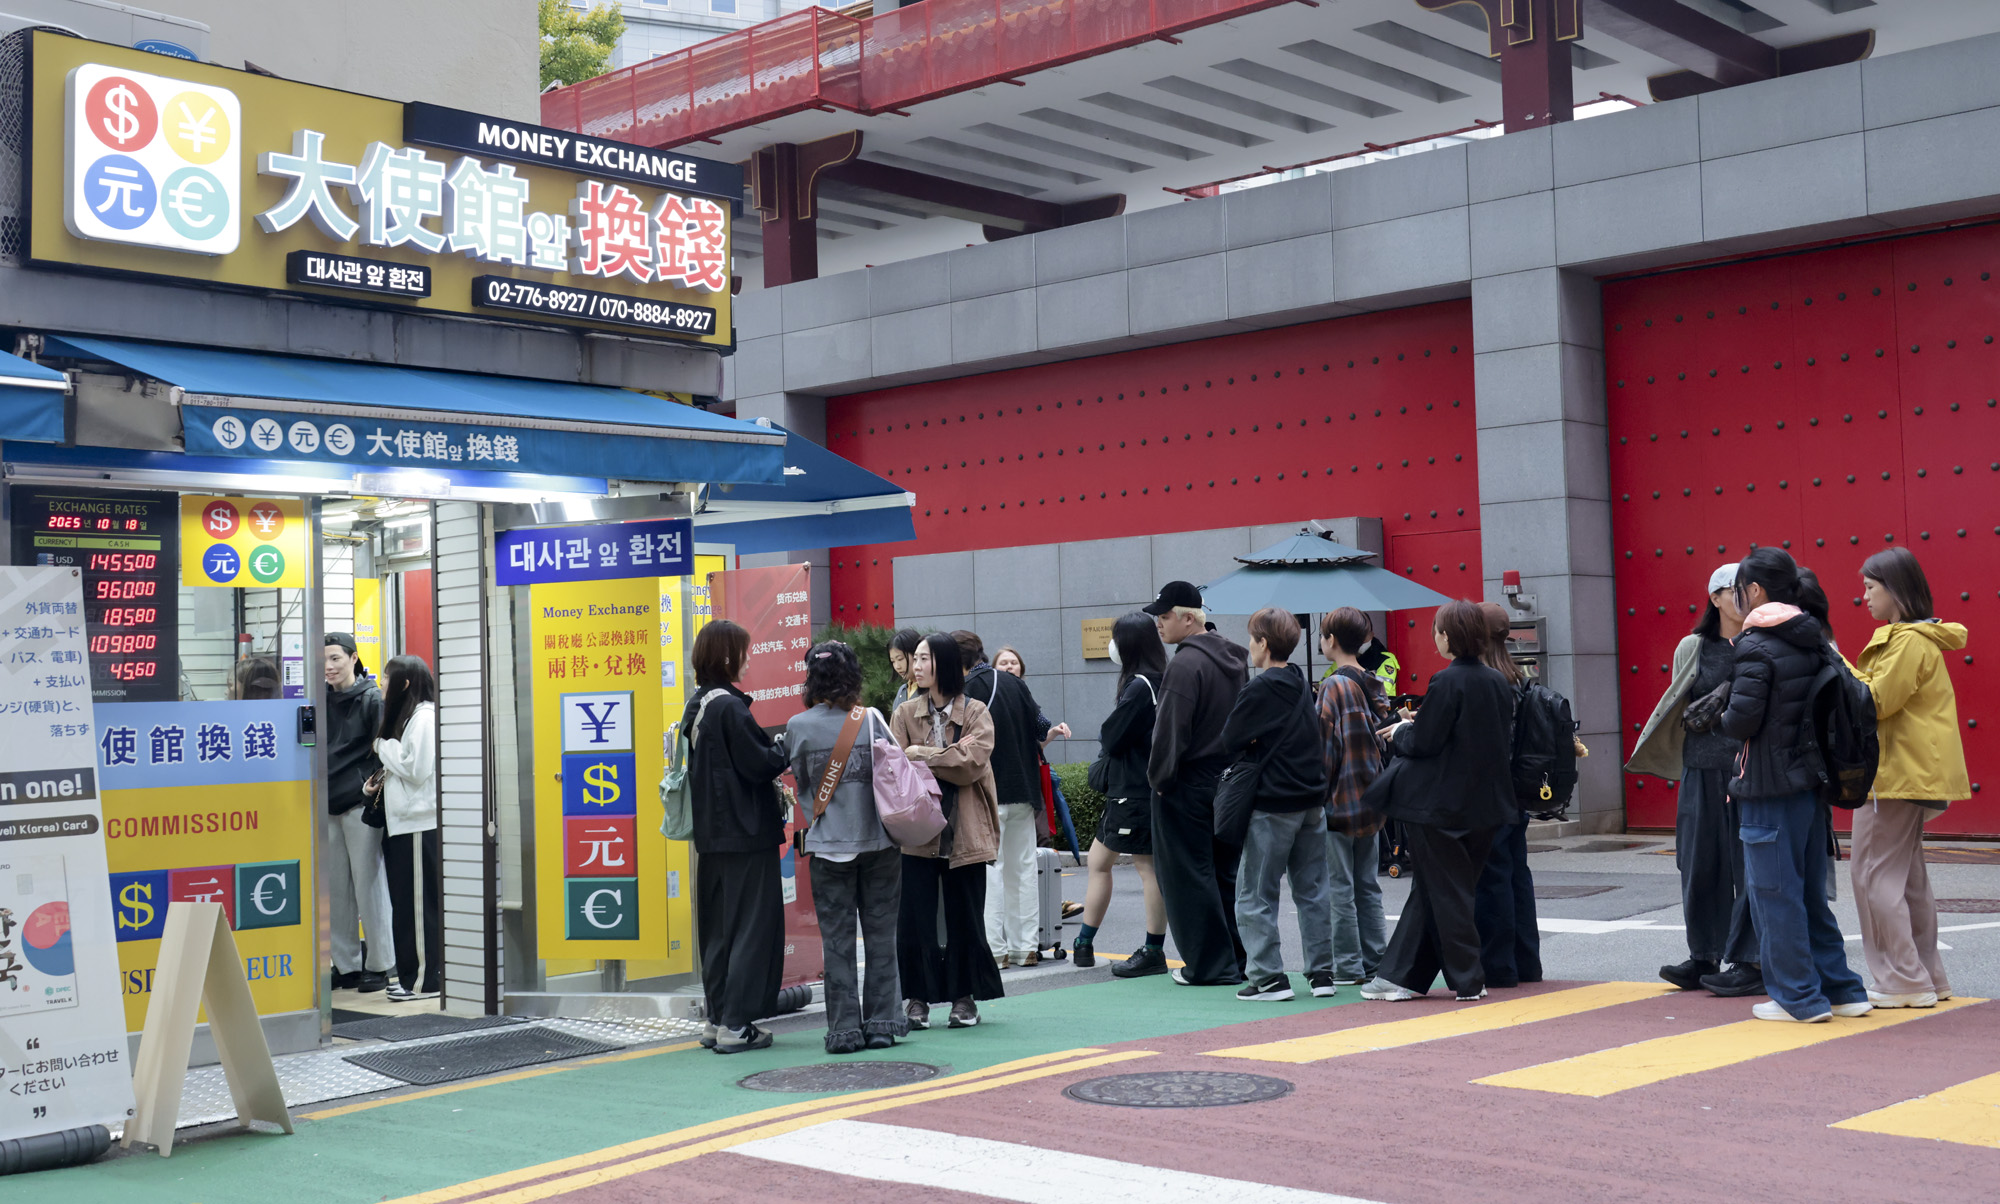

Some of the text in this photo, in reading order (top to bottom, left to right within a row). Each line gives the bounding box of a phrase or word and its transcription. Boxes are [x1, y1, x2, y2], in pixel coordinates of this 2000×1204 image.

[478, 122, 698, 184] MONEY EXCHANGE
[98, 167, 145, 214] 元
[306, 256, 425, 292] 대사관 앞 환전
[487, 280, 588, 315] 02-776-8927
[599, 297, 712, 331] 070-8884-8927
[49, 501, 148, 516] EXCHANGE RATES
[48, 516, 81, 529] 2025
[97, 518, 110, 530] 10
[125, 519, 138, 530] 18
[38, 538, 73, 546] CURRENCY
[510, 531, 683, 573] 대사관 앞 환전
[56, 556, 74, 565] USD
[209, 552, 236, 575] 元
[776, 590, 808, 606] 货币兑换
[25, 601, 77, 615] 外貨両替
[543, 603, 650, 619] Money Exchange
[785, 613, 809, 628] 交通卡
[14, 626, 80, 640] 交通カード
[46, 675, 85, 688] 支払い
[91, 689, 127, 697] MMISSION
[50, 723, 90, 737] 落ちず
[25, 773, 83, 799] one!
[818, 759, 843, 803] CELINE
[19, 821, 60, 835] K(orea)
[62, 819, 88, 831] Card
[107, 810, 259, 839] COMMISSION
[578, 826, 625, 867] 元
[246, 953, 294, 981] EUR
[9, 1076, 67, 1097] ください
